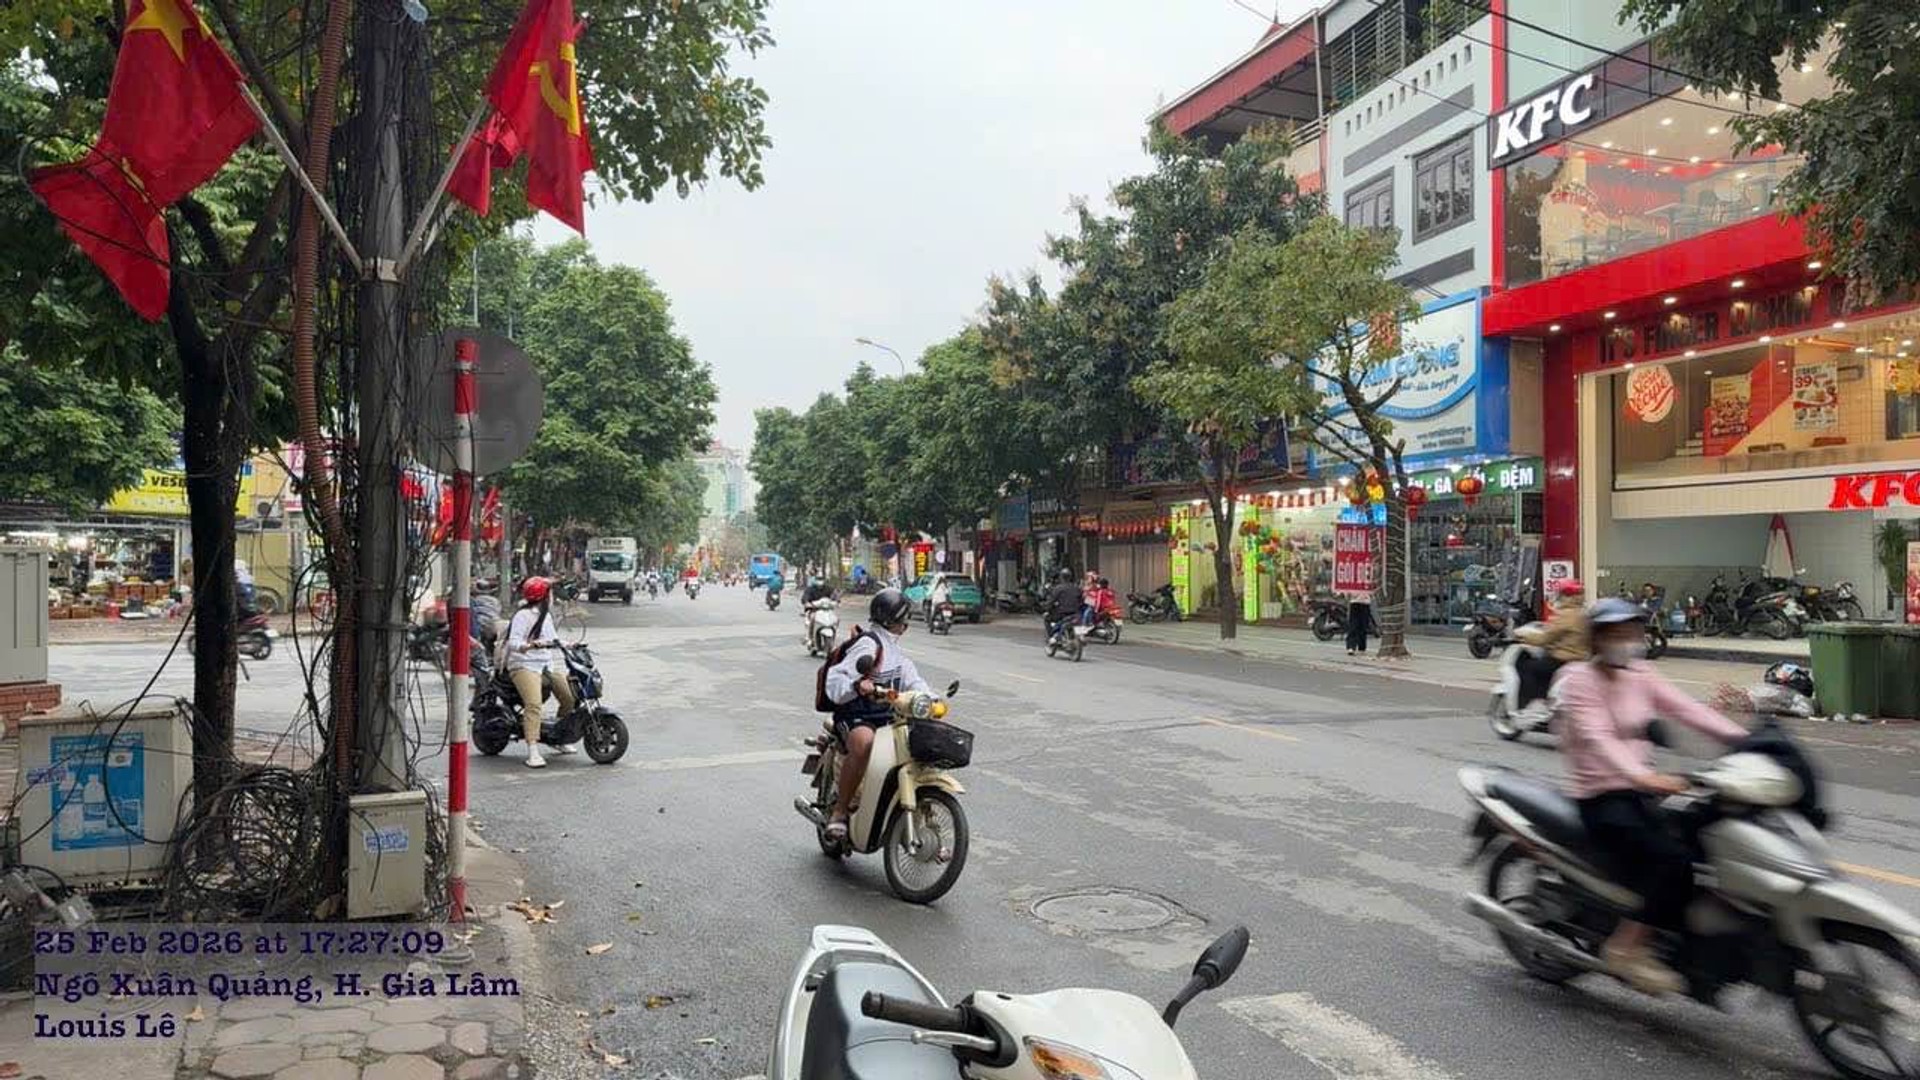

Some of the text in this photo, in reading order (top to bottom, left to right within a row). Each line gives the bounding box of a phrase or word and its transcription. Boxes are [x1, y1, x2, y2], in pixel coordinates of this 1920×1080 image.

[1493, 74, 1593, 159] KFC
[1434, 477, 1451, 494] GA
[1501, 466, 1533, 490] ĐỆM
